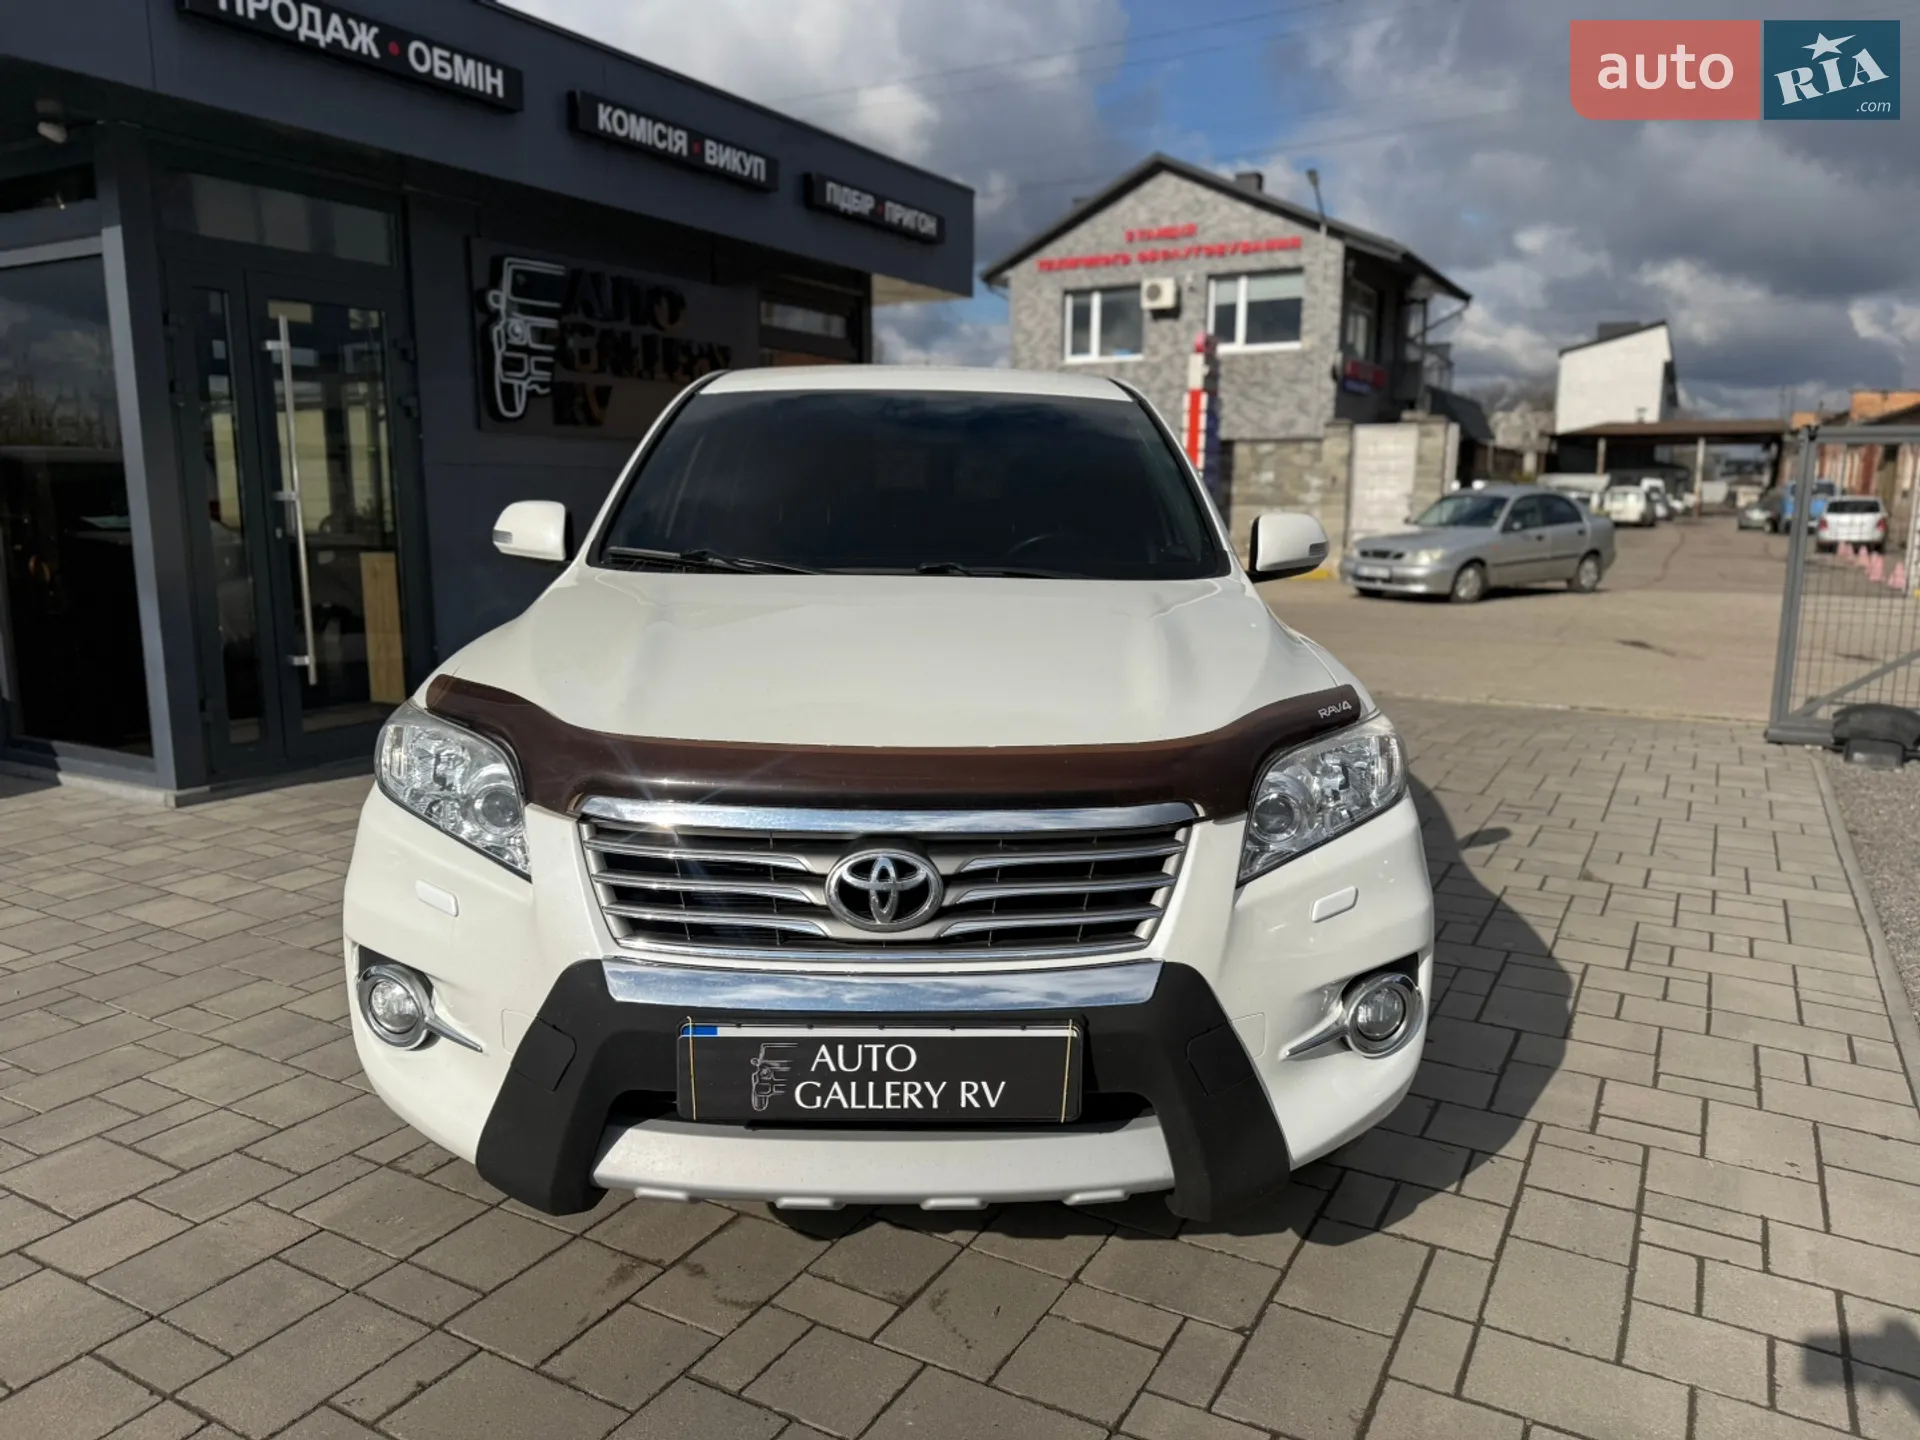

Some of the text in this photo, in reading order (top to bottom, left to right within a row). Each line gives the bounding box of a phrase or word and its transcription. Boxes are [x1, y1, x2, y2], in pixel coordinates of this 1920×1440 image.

[407, 40, 505, 99] ОБМІН
[597, 103, 767, 183] КОМІСІЯ ВИКУП
[825, 181, 938, 237] ПІДБІР ПРИГОН
[1317, 700, 1353, 719] RAV4
[810, 1043, 918, 1072] AUTO
[794, 1080, 1006, 1109] GALLERY RV
